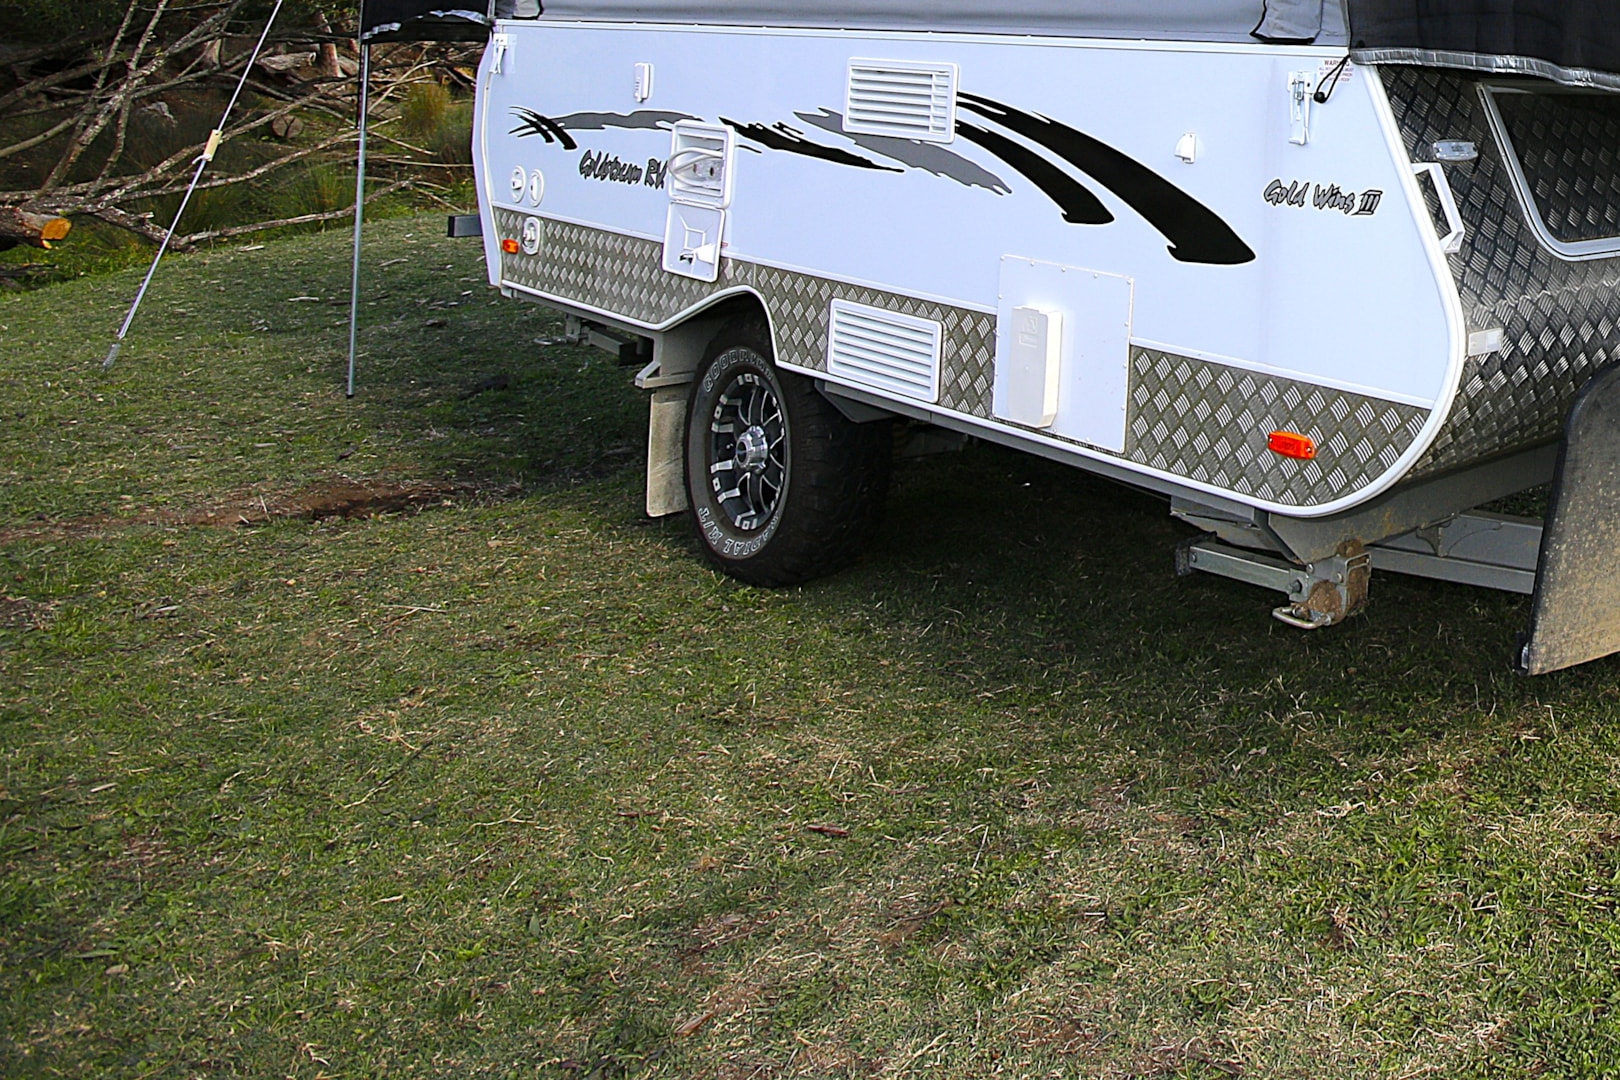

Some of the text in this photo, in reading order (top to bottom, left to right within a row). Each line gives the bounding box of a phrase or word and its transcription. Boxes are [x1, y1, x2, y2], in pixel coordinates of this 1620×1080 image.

[1324, 59, 1350, 67] WARG
[579, 149, 643, 185] Goldstream
[1263, 178, 1310, 208] Gold
[1351, 189, 1384, 216] III
